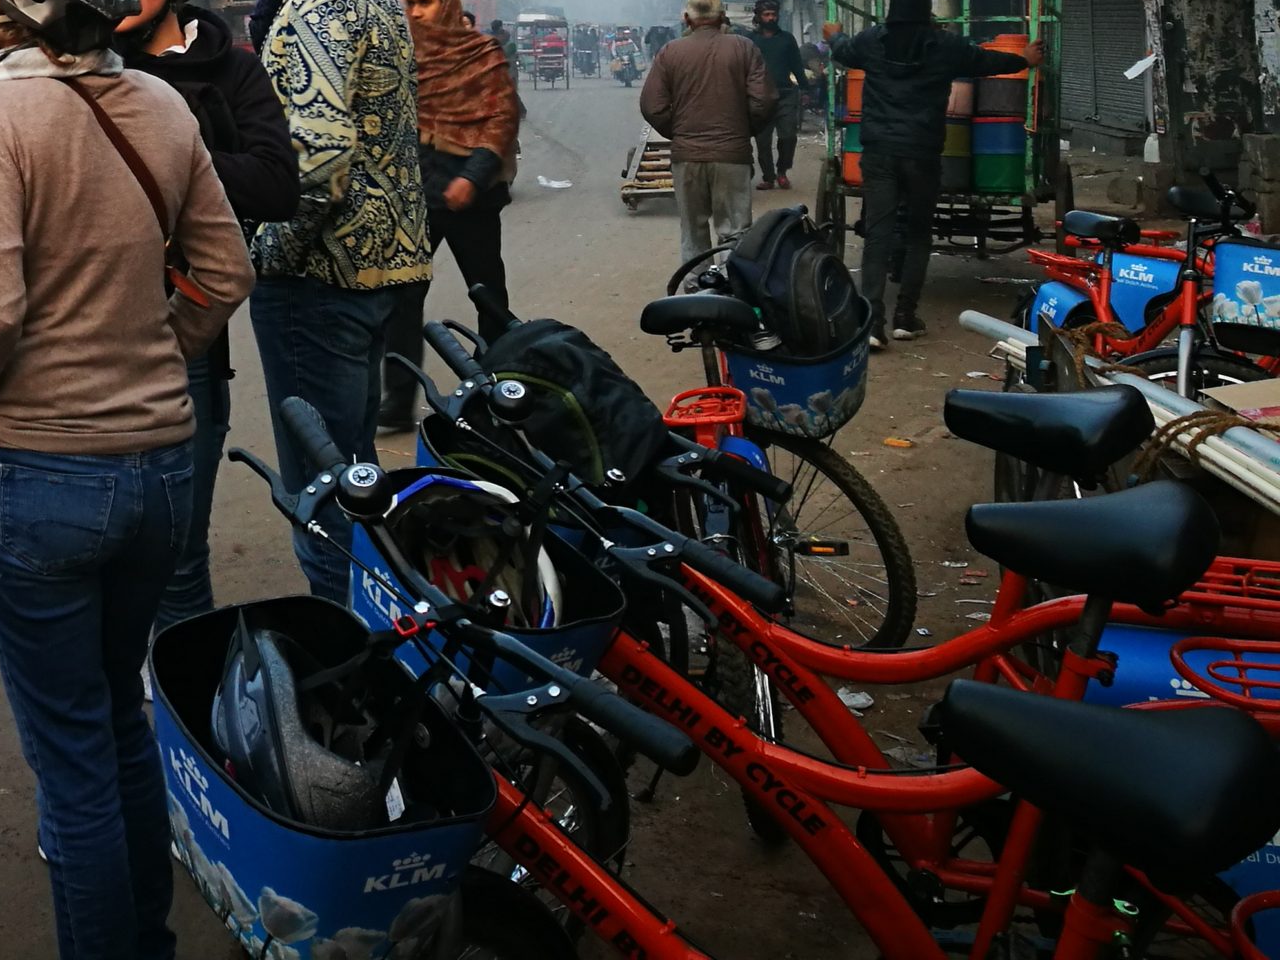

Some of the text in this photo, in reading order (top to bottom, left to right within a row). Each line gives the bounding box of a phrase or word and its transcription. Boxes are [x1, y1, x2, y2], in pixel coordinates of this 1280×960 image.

[1119, 268, 1155, 284] KLM
[1242, 262, 1280, 277] KLM
[1040, 301, 1058, 319] KLM
[748, 368, 786, 386] KLM
[717, 610, 816, 705] BY CYCLE
[620, 663, 827, 837] DELHI BY CYCLE
[170, 746, 230, 840] KLM
[363, 863, 447, 894] KLM
[513, 833, 610, 926] DELHI
